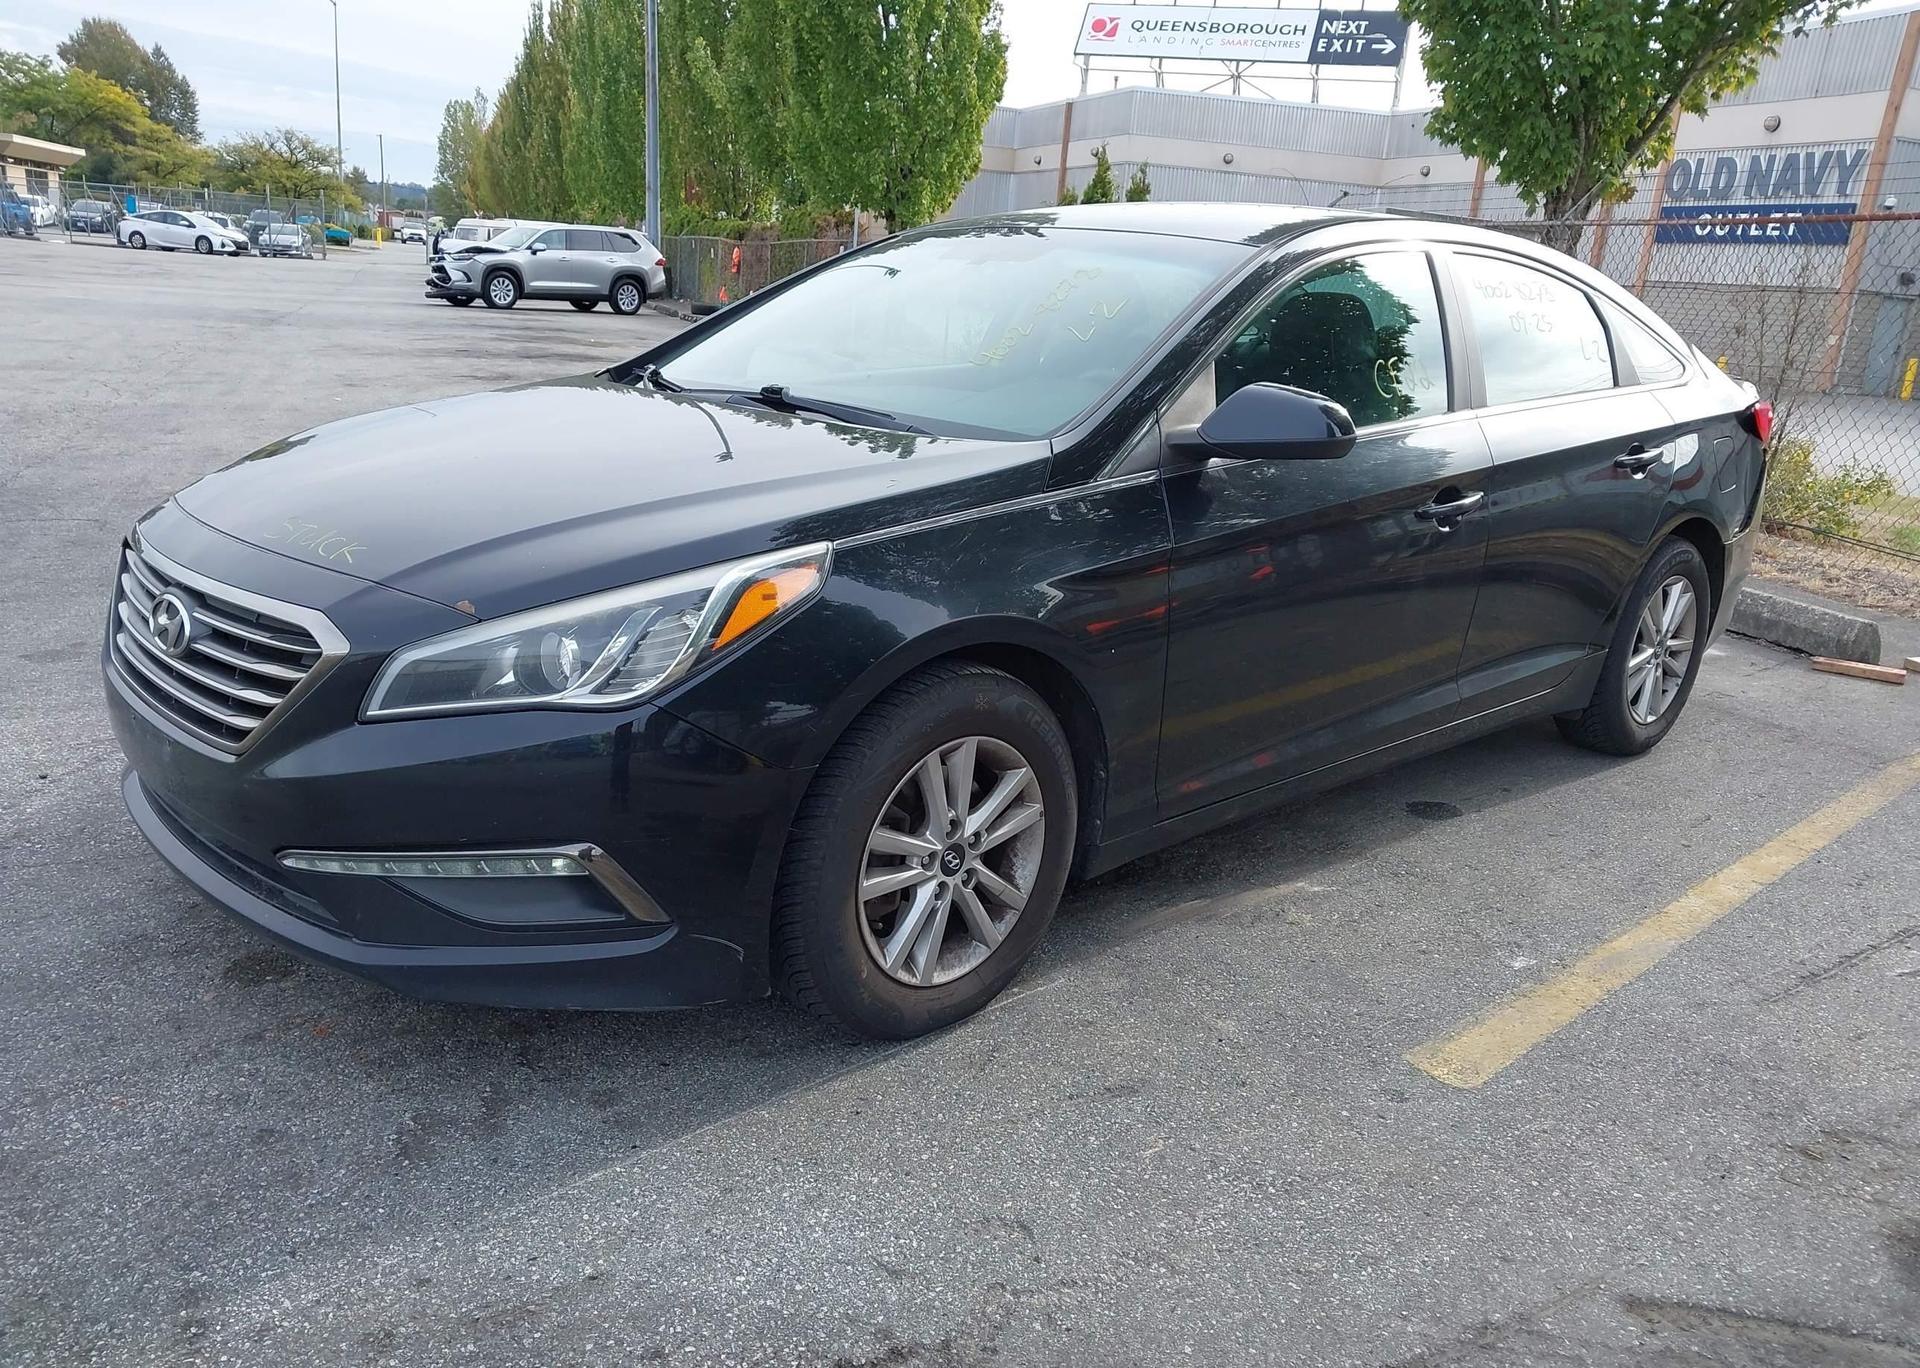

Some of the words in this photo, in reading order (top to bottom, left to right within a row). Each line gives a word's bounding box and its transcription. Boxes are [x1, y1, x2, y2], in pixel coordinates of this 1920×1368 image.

[1131, 19, 1307, 36] QUEENSBOROUGH
[1321, 19, 1369, 34] NEXT
[1128, 36, 1214, 47] LANDING
[1220, 38, 1301, 49] SMARTCENTRES
[1317, 38, 1366, 53] EXIT
[1666, 156, 1738, 199] OLD
[1745, 148, 1868, 199] NAVY
[1695, 212, 1802, 236] OUTLET
